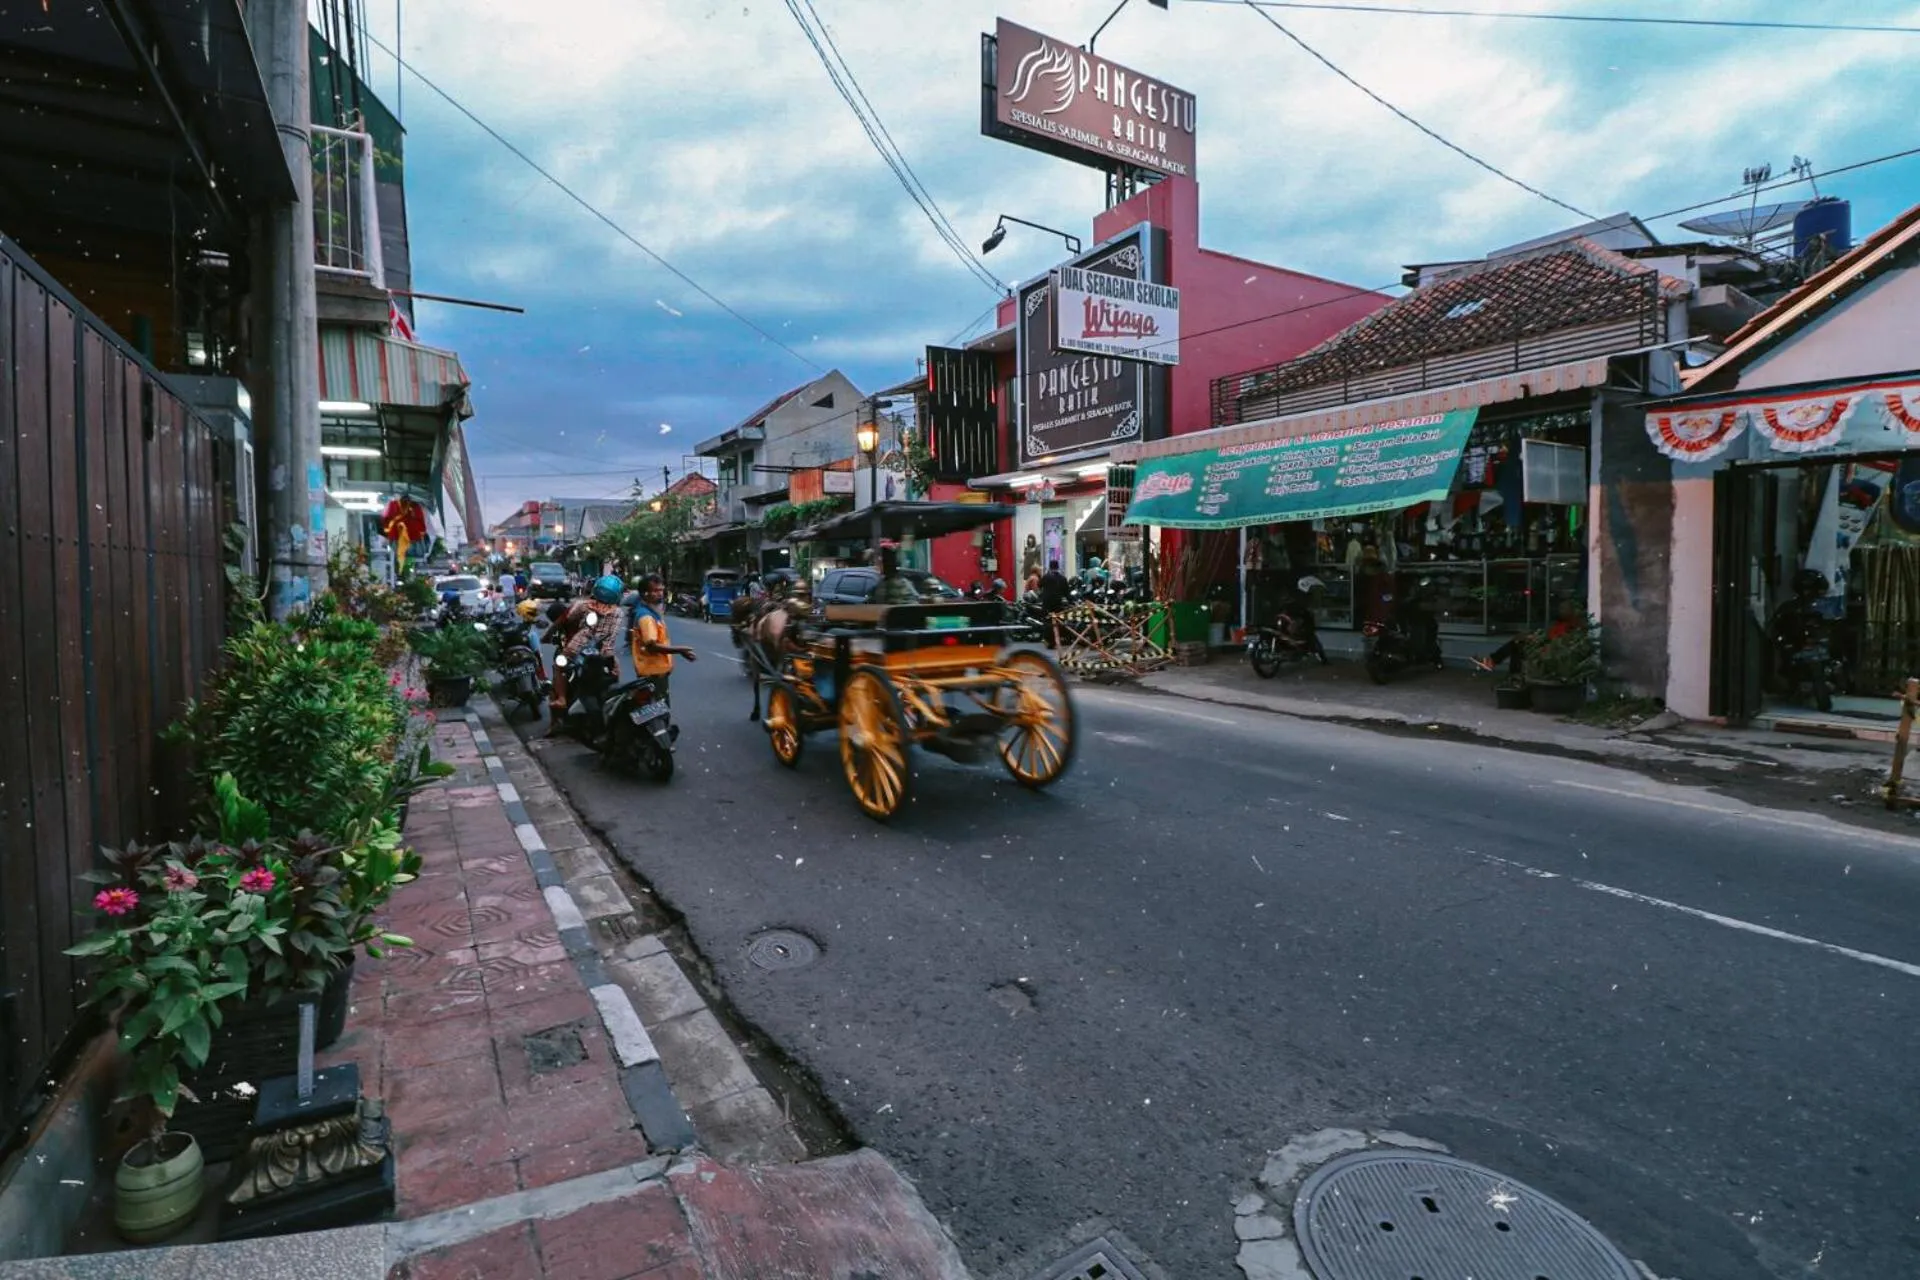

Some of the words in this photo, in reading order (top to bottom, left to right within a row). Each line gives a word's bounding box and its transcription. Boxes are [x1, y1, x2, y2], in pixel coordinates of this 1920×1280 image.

[1078, 54, 1194, 133] PANGESTU
[1010, 108, 1057, 132] SPESIALIS
[1115, 143, 1159, 167] SERAGAM
[1161, 158, 1186, 175] BATIK
[1113, 114, 1167, 153] BATIK
[1060, 267, 1084, 290] JUAL
[1086, 273, 1135, 300] SERAGAM
[1137, 282, 1179, 310] SEKOLAH
[1082, 295, 1159, 340] Wijaya
[1059, 386, 1098, 415] BATIK
